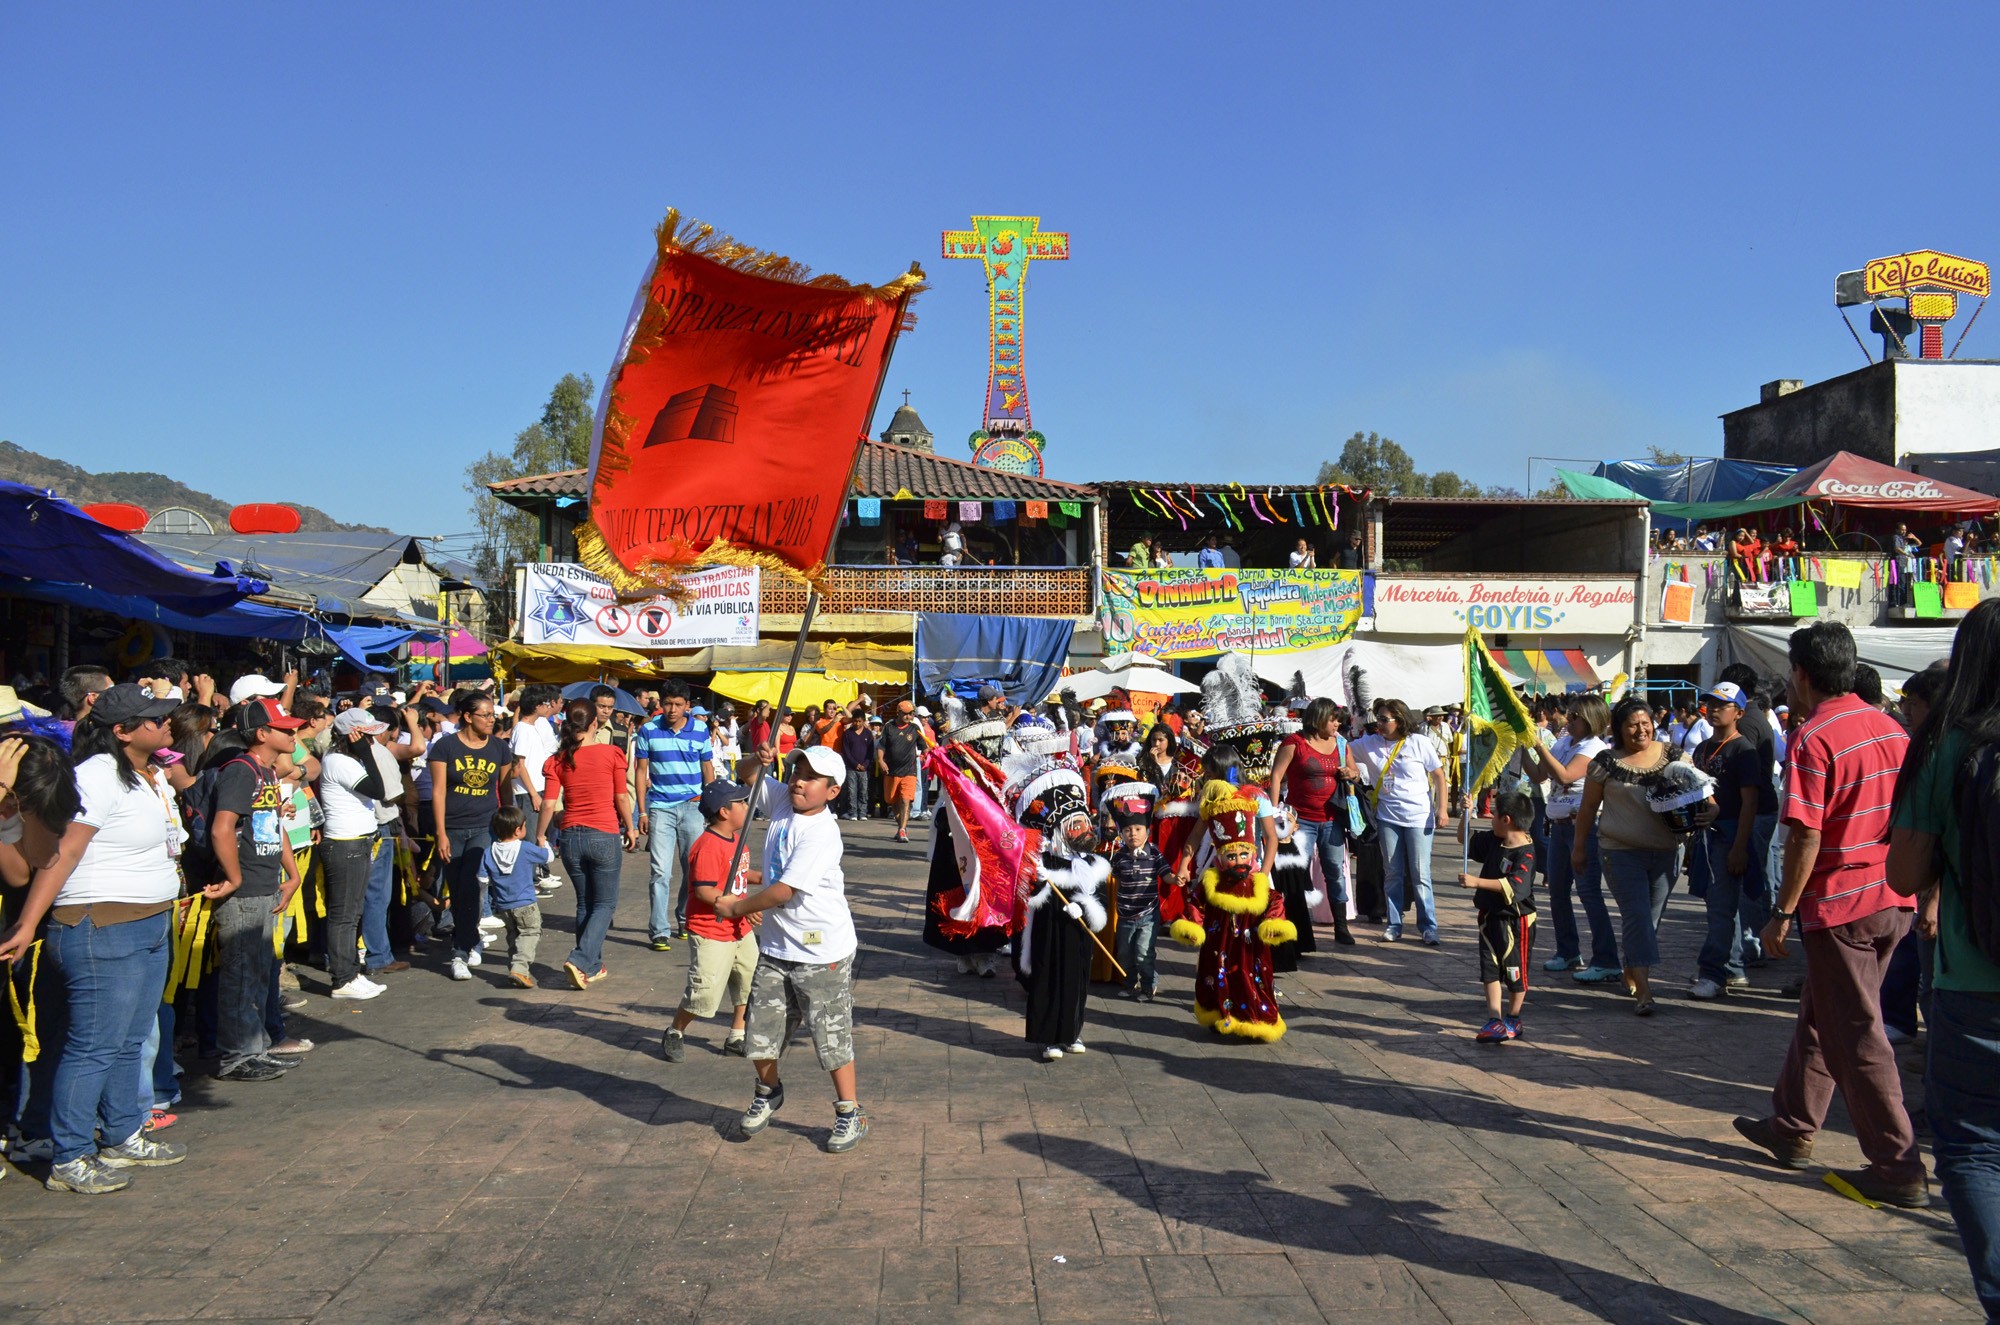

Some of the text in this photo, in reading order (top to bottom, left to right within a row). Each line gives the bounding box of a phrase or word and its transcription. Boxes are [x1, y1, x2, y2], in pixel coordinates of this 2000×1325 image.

[946, 229, 1065, 255] TWISTER
[651, 284, 763, 335] OMPARZA
[995, 290, 1018, 391] EXTREME
[988, 442, 1029, 458] TWISTER
[1818, 478, 1942, 499] Coca-Cola
[645, 500, 783, 544] TEPOZTLAN
[776, 494, 819, 546] 2013
[533, 563, 564, 577] QUEDA
[702, 567, 754, 583] TRANSITAR
[1303, 569, 1340, 581] CRUZ
[1135, 575, 1238, 609] DINAMITA
[1237, 580, 1300, 614] Tequilera
[1565, 584, 1635, 608] Regalos
[696, 601, 711, 615] VÍA
[714, 600, 754, 615] PÚBLICA
[1311, 604, 1321, 614] de
[1466, 605, 1553, 631] GOYIS
[1101, 608, 1134, 643] 10
[1135, 620, 1203, 640] Cadetes
[650, 638, 668, 646] BANDO
[1216, 628, 1286, 650] Cascabel
[454, 785, 470, 795] ATH
